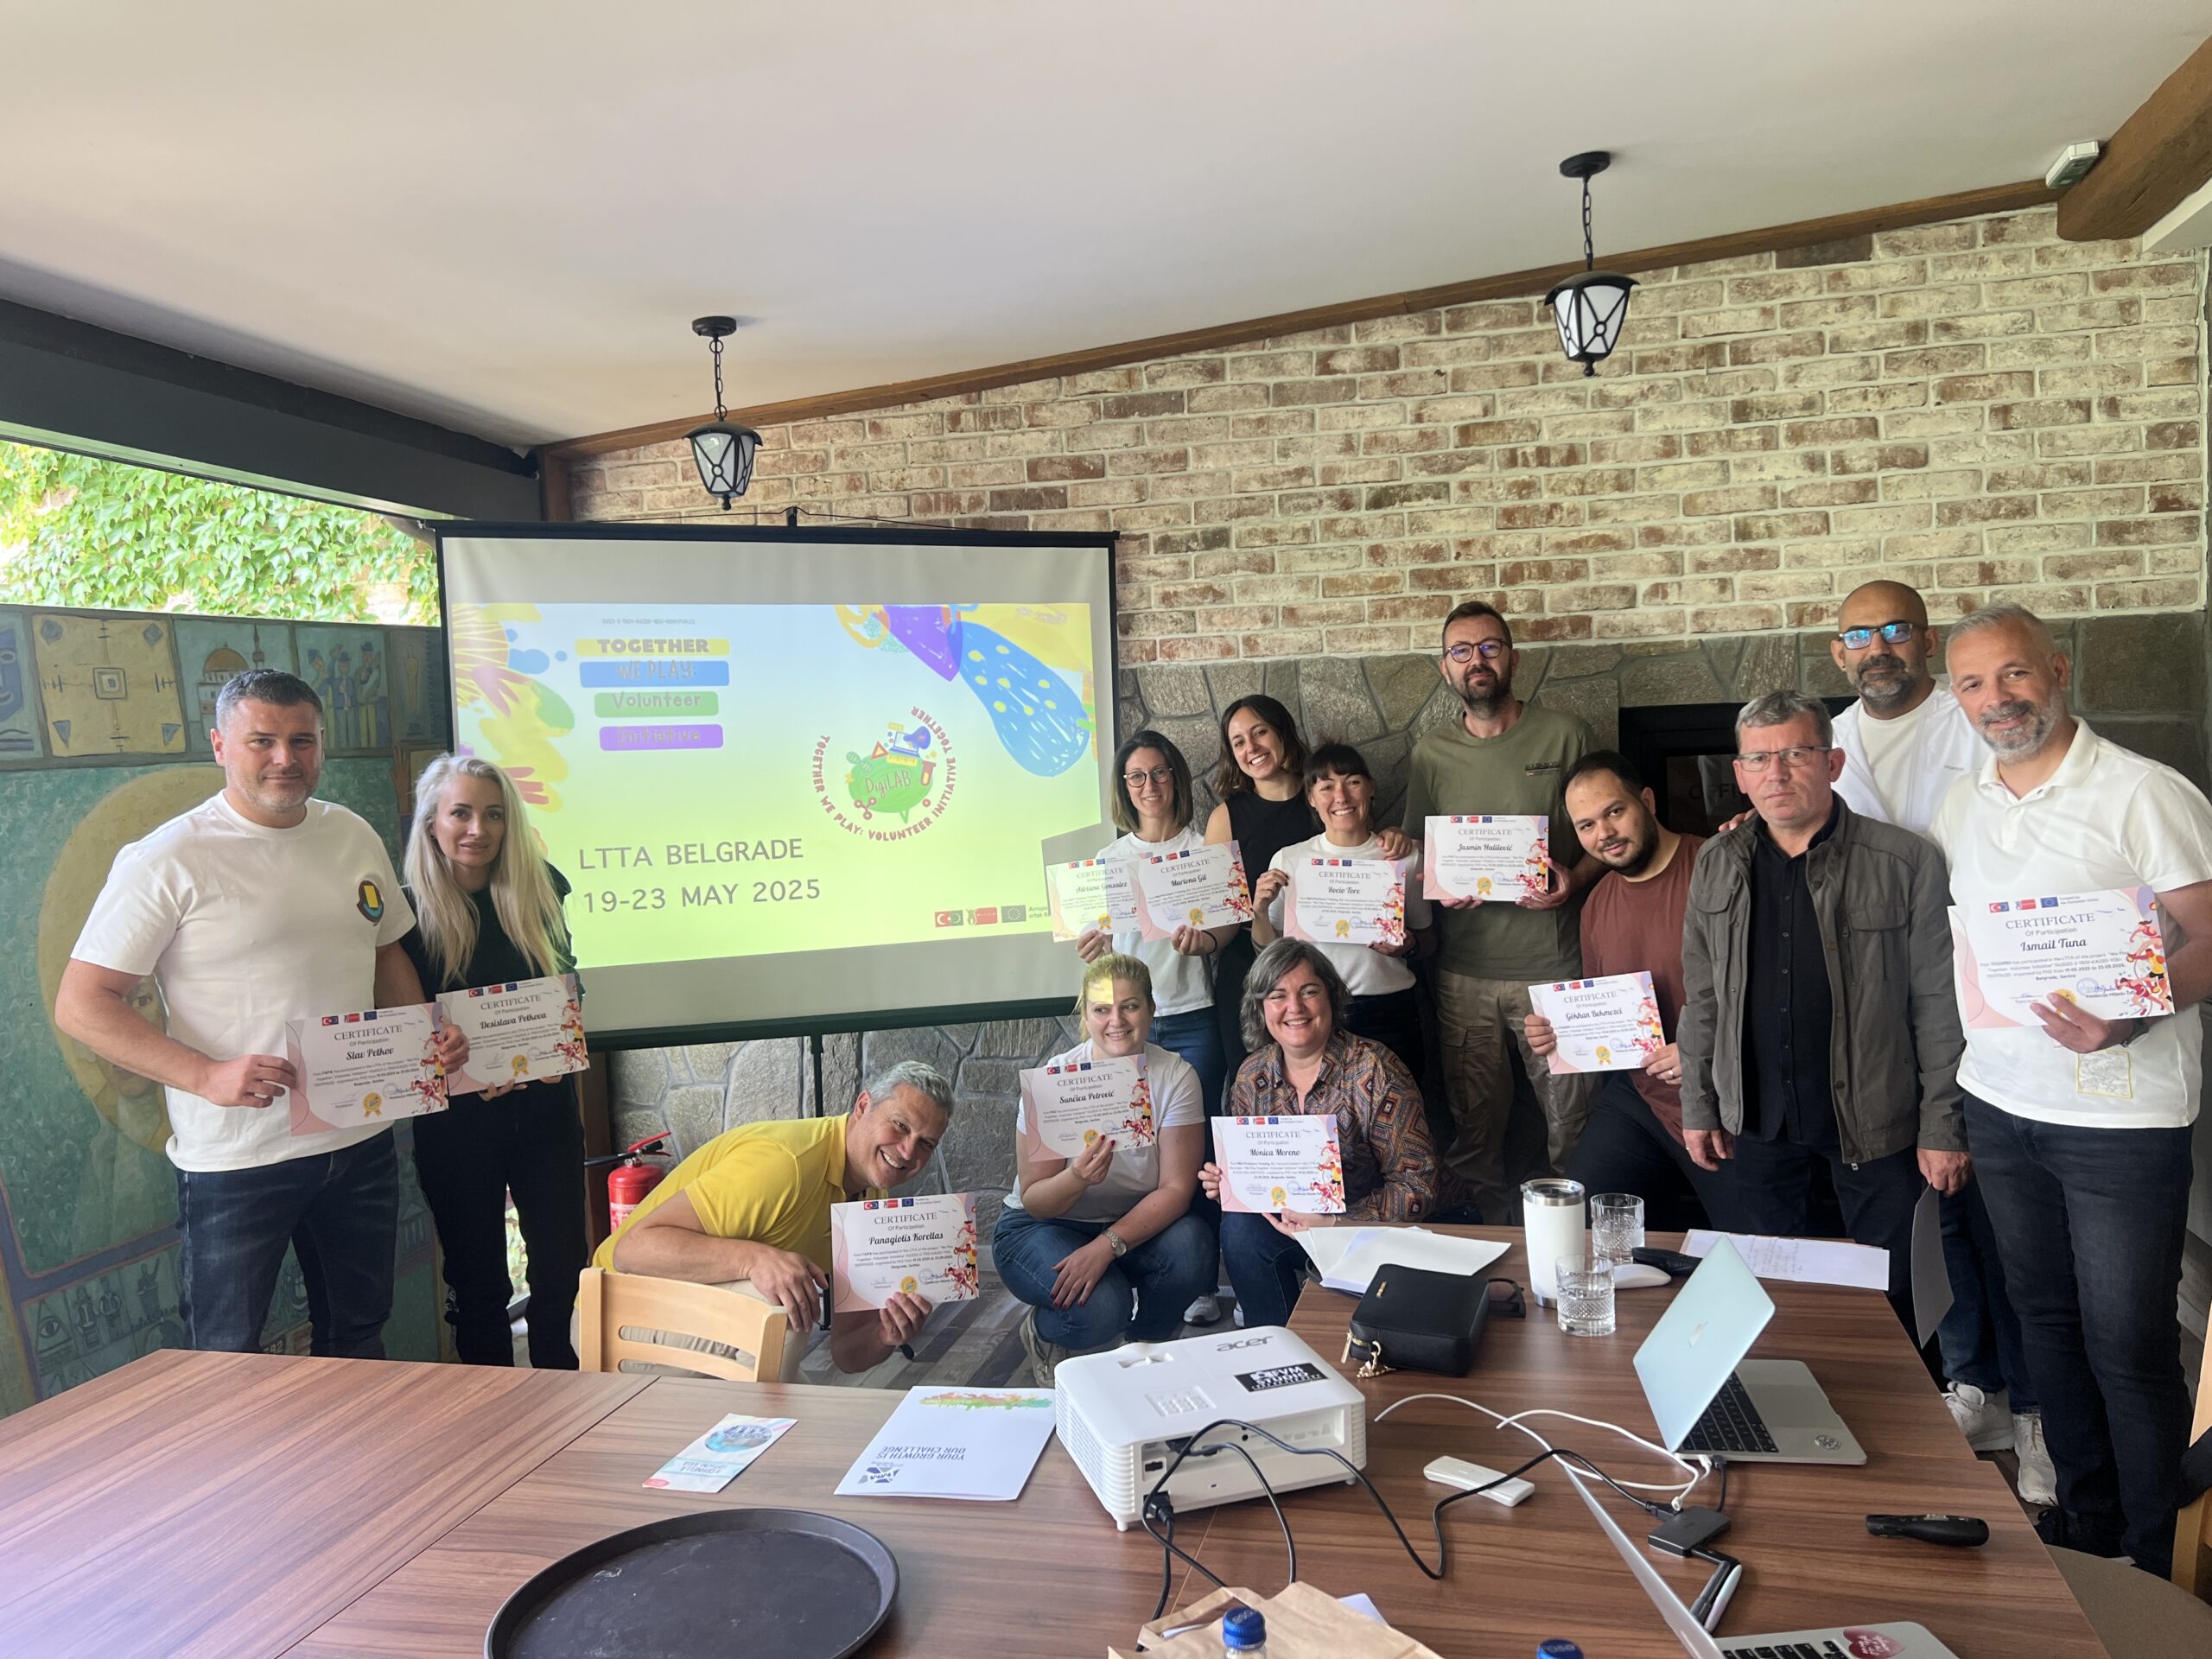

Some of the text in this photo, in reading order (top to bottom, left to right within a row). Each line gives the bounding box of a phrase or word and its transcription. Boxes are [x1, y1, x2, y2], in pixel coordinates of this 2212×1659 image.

[597, 639, 709, 653] TOGETHER
[616, 660, 641, 680] WE
[612, 691, 702, 709] Volunteer
[617, 727, 701, 747] Initiative
[911, 706, 952, 754] TOGETHER
[812, 735, 830, 793] TOGETHER
[865, 769, 912, 798] DigiLAB
[931, 757, 957, 817] INITIATIVE
[820, 795, 836, 814] WE
[868, 817, 932, 842] VOLUNTEER
[579, 838, 804, 869] LTTA BELGRADE
[1077, 868, 1124, 878] CERTIFICATE
[1160, 858, 1210, 873] CERTIFICATE
[1171, 874, 1206, 887] Mariona Gil
[583, 879, 821, 913] 19-23 MAY 2025
[2005, 912, 2094, 929] CERTIFICATE
[2035, 926, 2077, 937] Participation
[2019, 937, 2088, 951] Ismail Tuna
[480, 994, 541, 1010] CERTIFICATE
[1563, 990, 1617, 1003] CERTIFICATE
[480, 1011, 546, 1029] Desislava Petkova
[1565, 1010, 1590, 1021] Gökhan
[334, 1024, 402, 1040] CERTIFICATE
[357, 1037, 388, 1046] Participation
[346, 1046, 394, 1060] Slav Petkov
[1057, 1073, 1112, 1086] CERTIFICATE
[874, 1212, 937, 1224] CERTIFICATE
[868, 1233, 911, 1247] Panagiotis
[1217, 1335, 1273, 1351] acer
[1256, 1372, 1309, 1386] STUDIO
